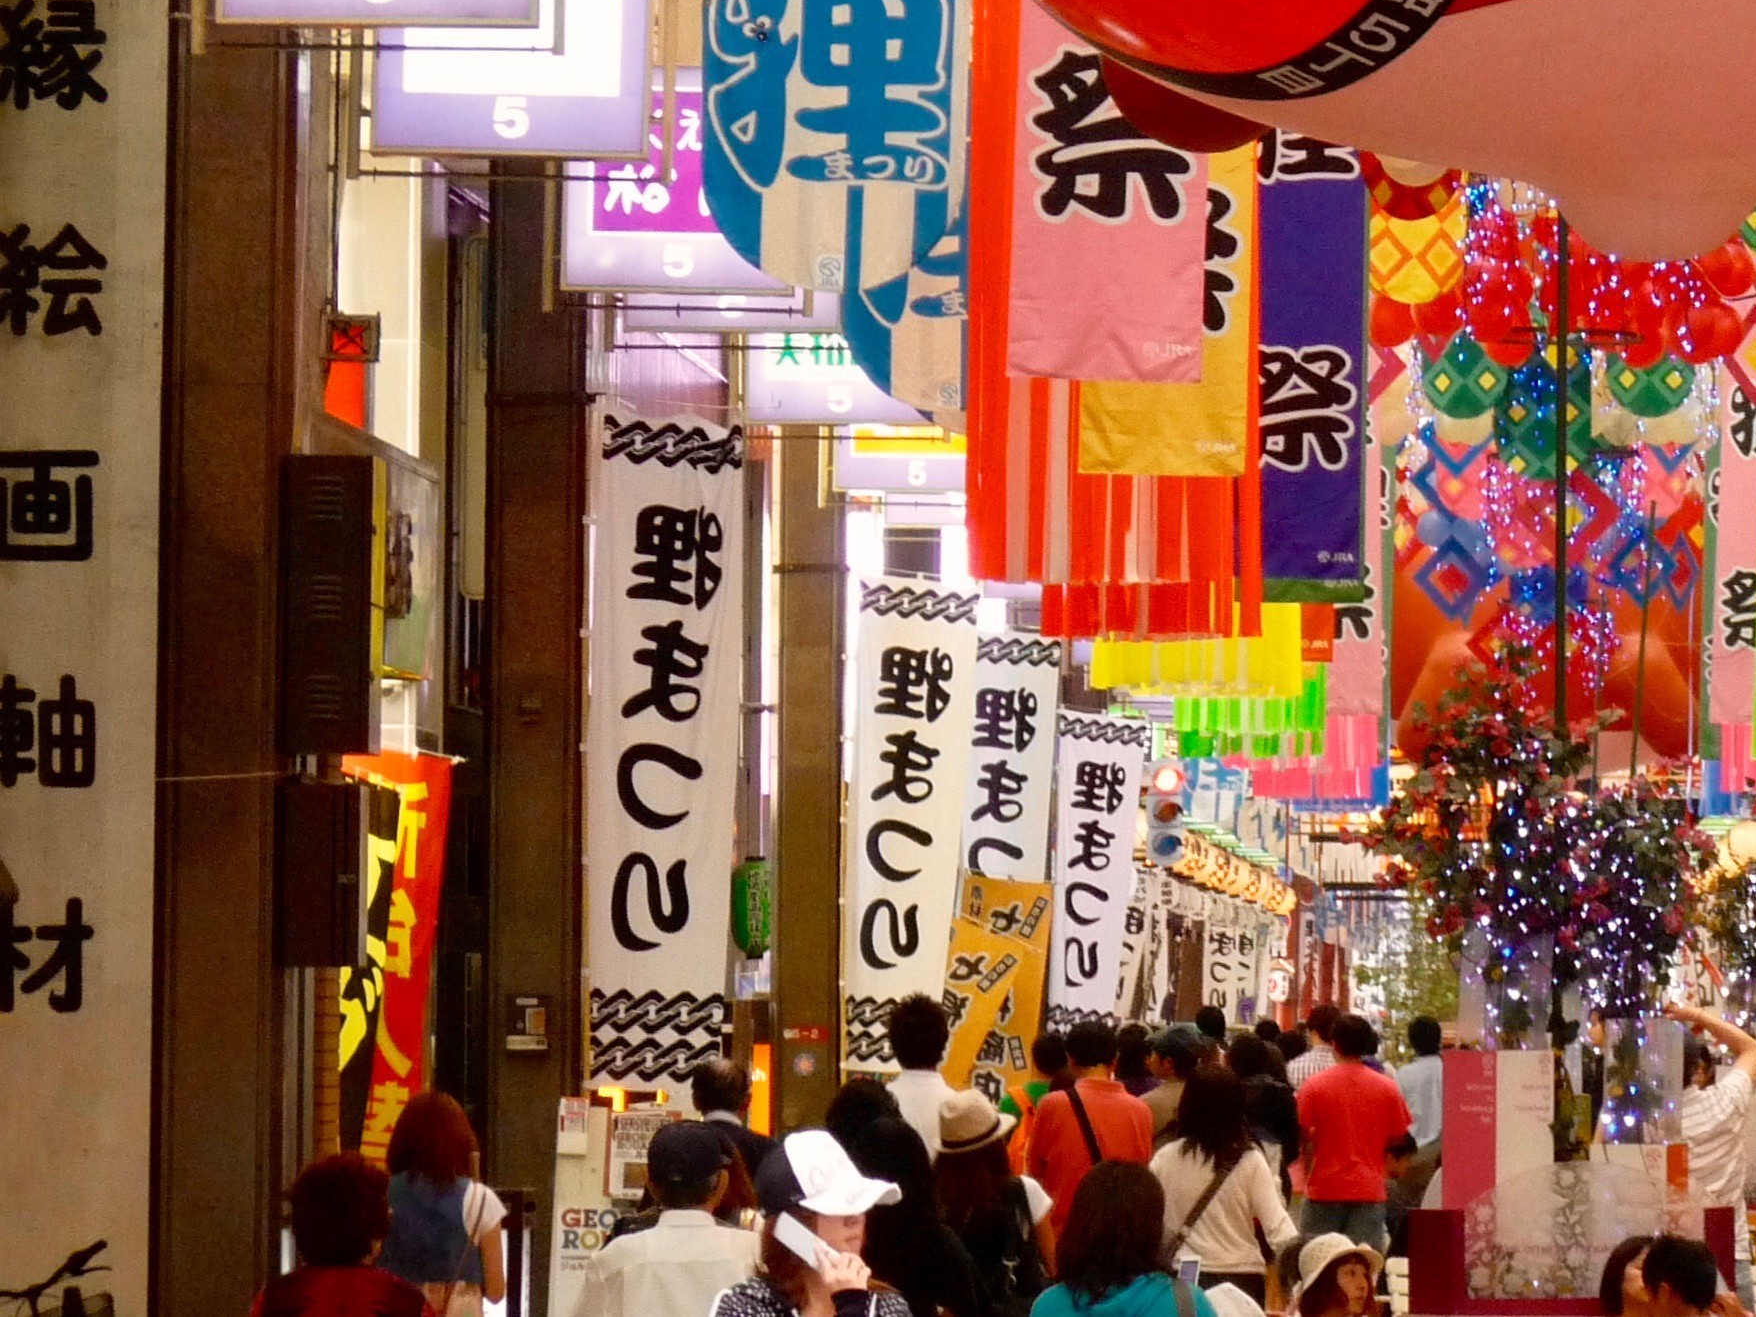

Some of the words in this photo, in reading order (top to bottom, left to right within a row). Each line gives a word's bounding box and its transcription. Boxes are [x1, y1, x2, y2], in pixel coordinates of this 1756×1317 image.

[493, 97, 529, 138] 5
[822, 150, 936, 184] まつり
[662, 245, 695, 278] 5
[0, 223, 107, 337] 絵
[826, 385, 853, 414] 5
[1260, 346, 1356, 472] 祭
[907, 459, 928, 486] 5
[0, 673, 96, 787] 軸
[562, 1231, 610, 1251] RO
